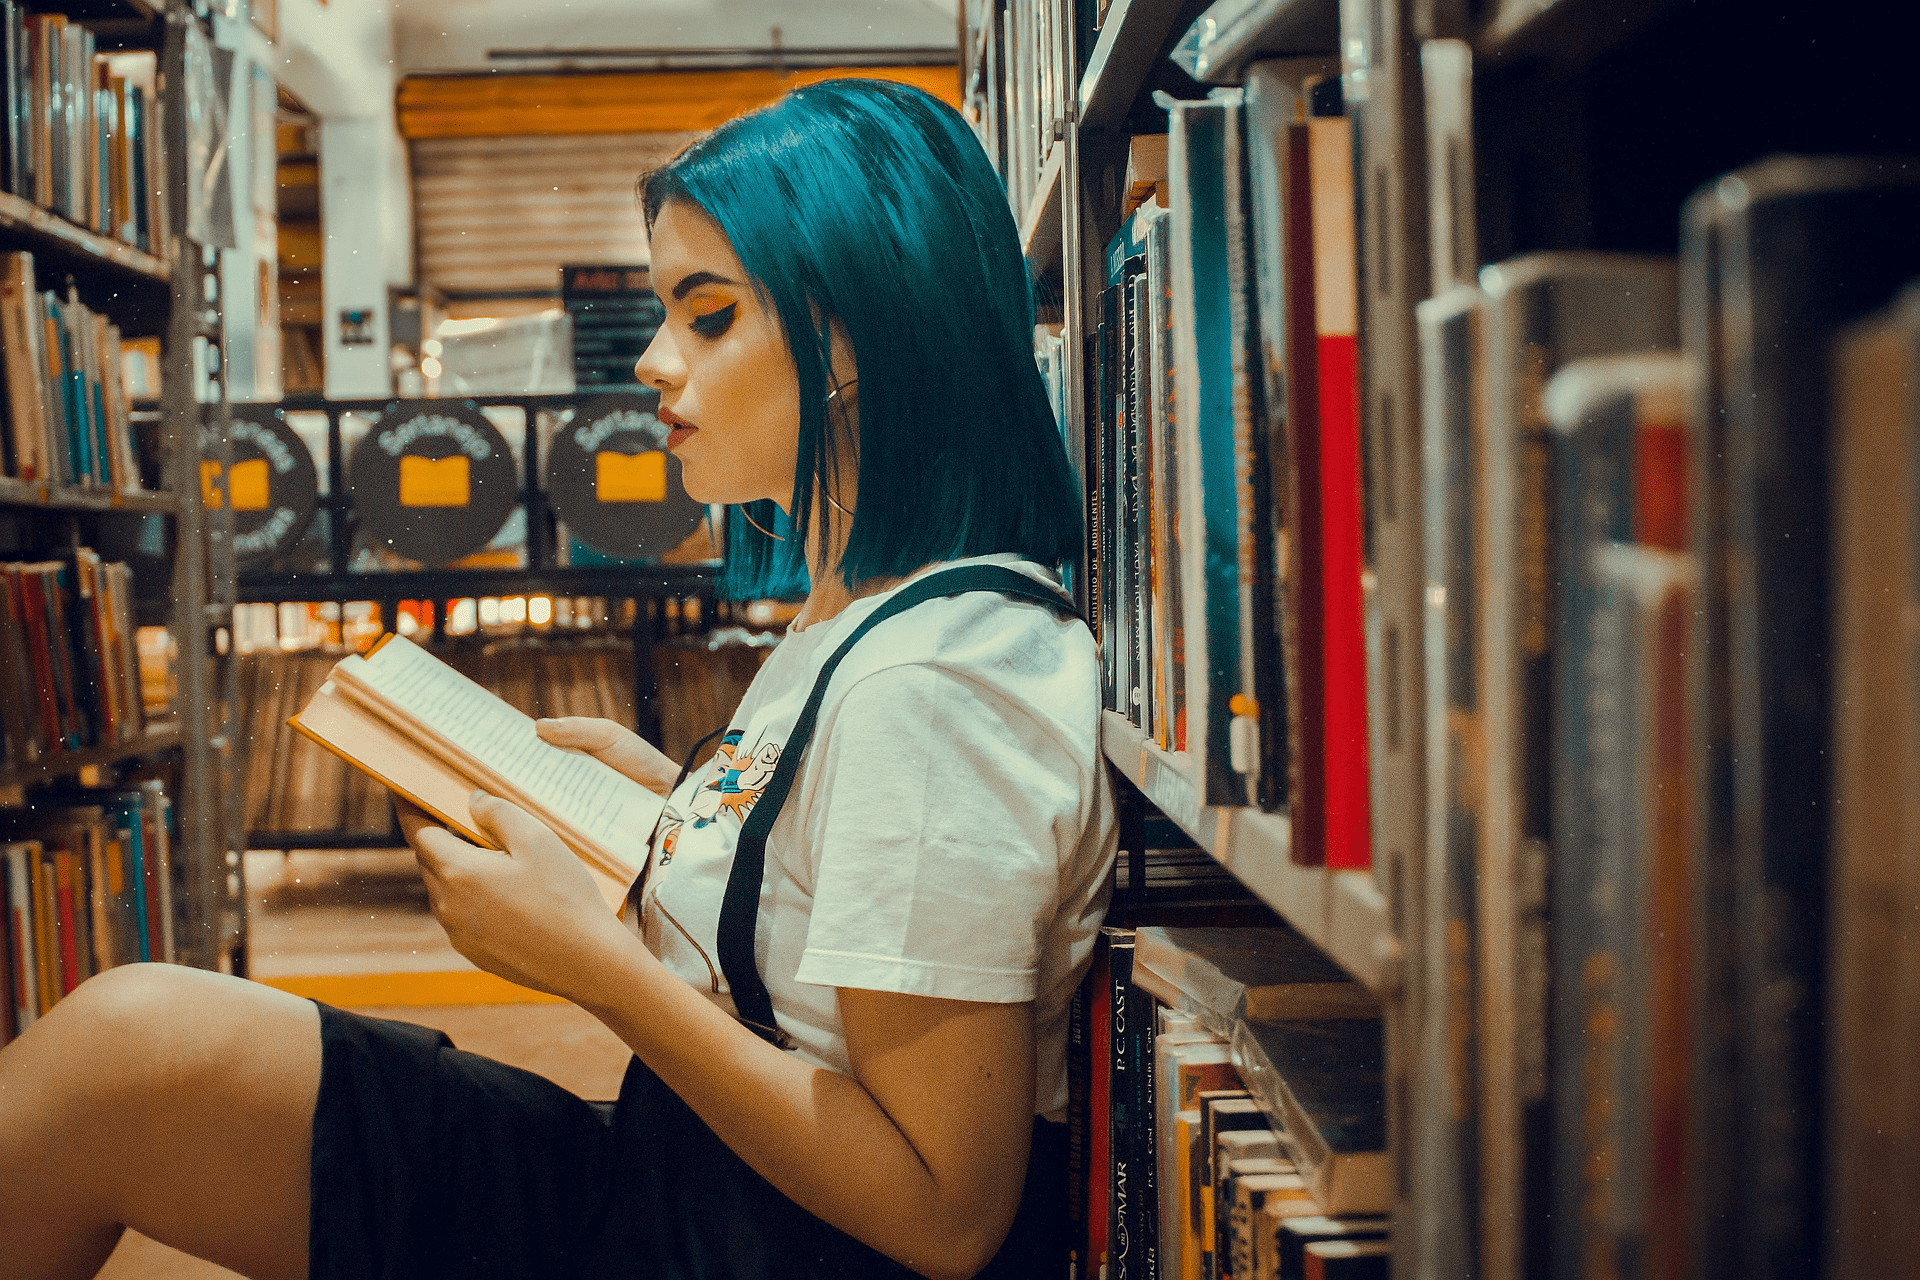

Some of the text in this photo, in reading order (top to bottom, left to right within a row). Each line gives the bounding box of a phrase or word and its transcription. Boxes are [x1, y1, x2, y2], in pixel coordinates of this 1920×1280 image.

[1091, 557, 1098, 570] DE
[1115, 979, 1126, 1033] CAST
[1145, 1026, 1153, 1054] Cast
[1117, 1161, 1127, 1216] MAR
